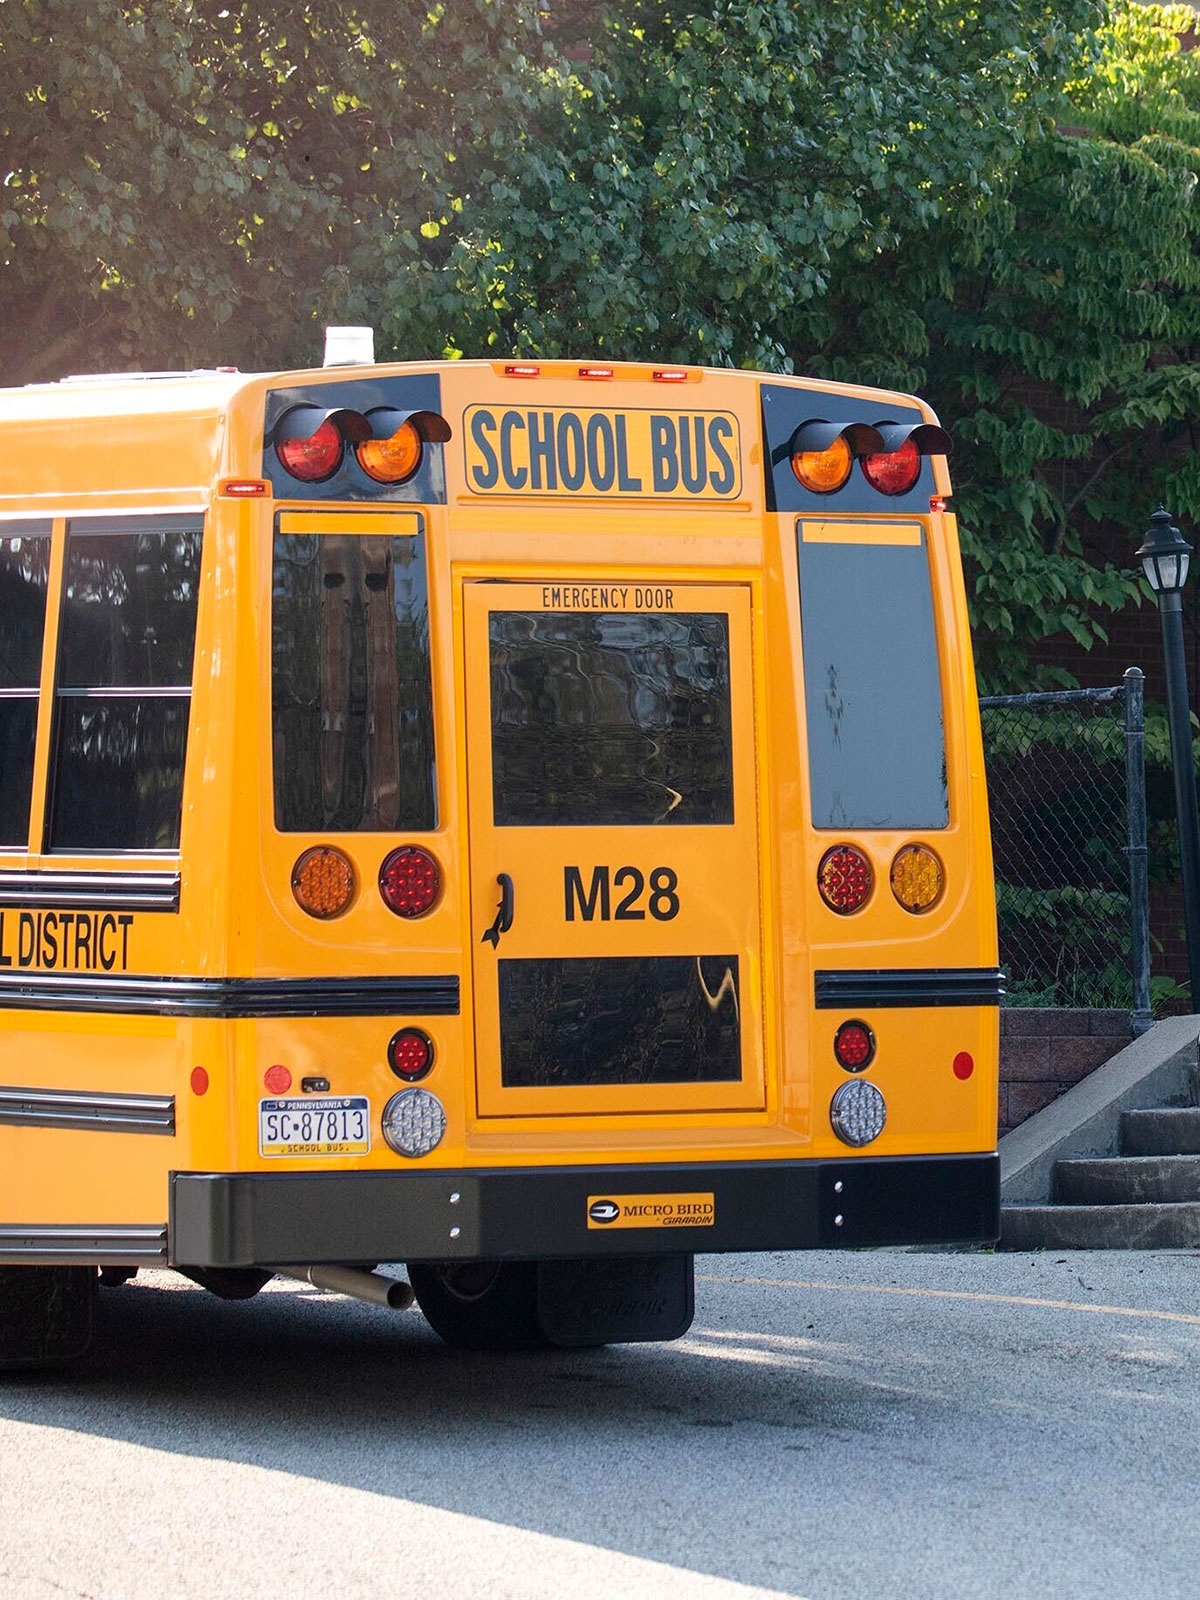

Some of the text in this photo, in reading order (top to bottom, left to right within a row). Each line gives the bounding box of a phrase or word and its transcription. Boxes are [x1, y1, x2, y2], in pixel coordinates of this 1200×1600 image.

[471, 409, 735, 494] SCHOOL BUS
[542, 587, 673, 609] EMERGENCY DOOR
[564, 866, 680, 921] M28
[18, 912, 134, 970] DISTRICT
[287, 1101, 343, 1110] PENNSYLVANIA
[287, 1143, 344, 1153] SCHOOL BUS
[623, 1203, 713, 1217] MICRO BIRD
[662, 1216, 713, 1225] GIRARDIN
